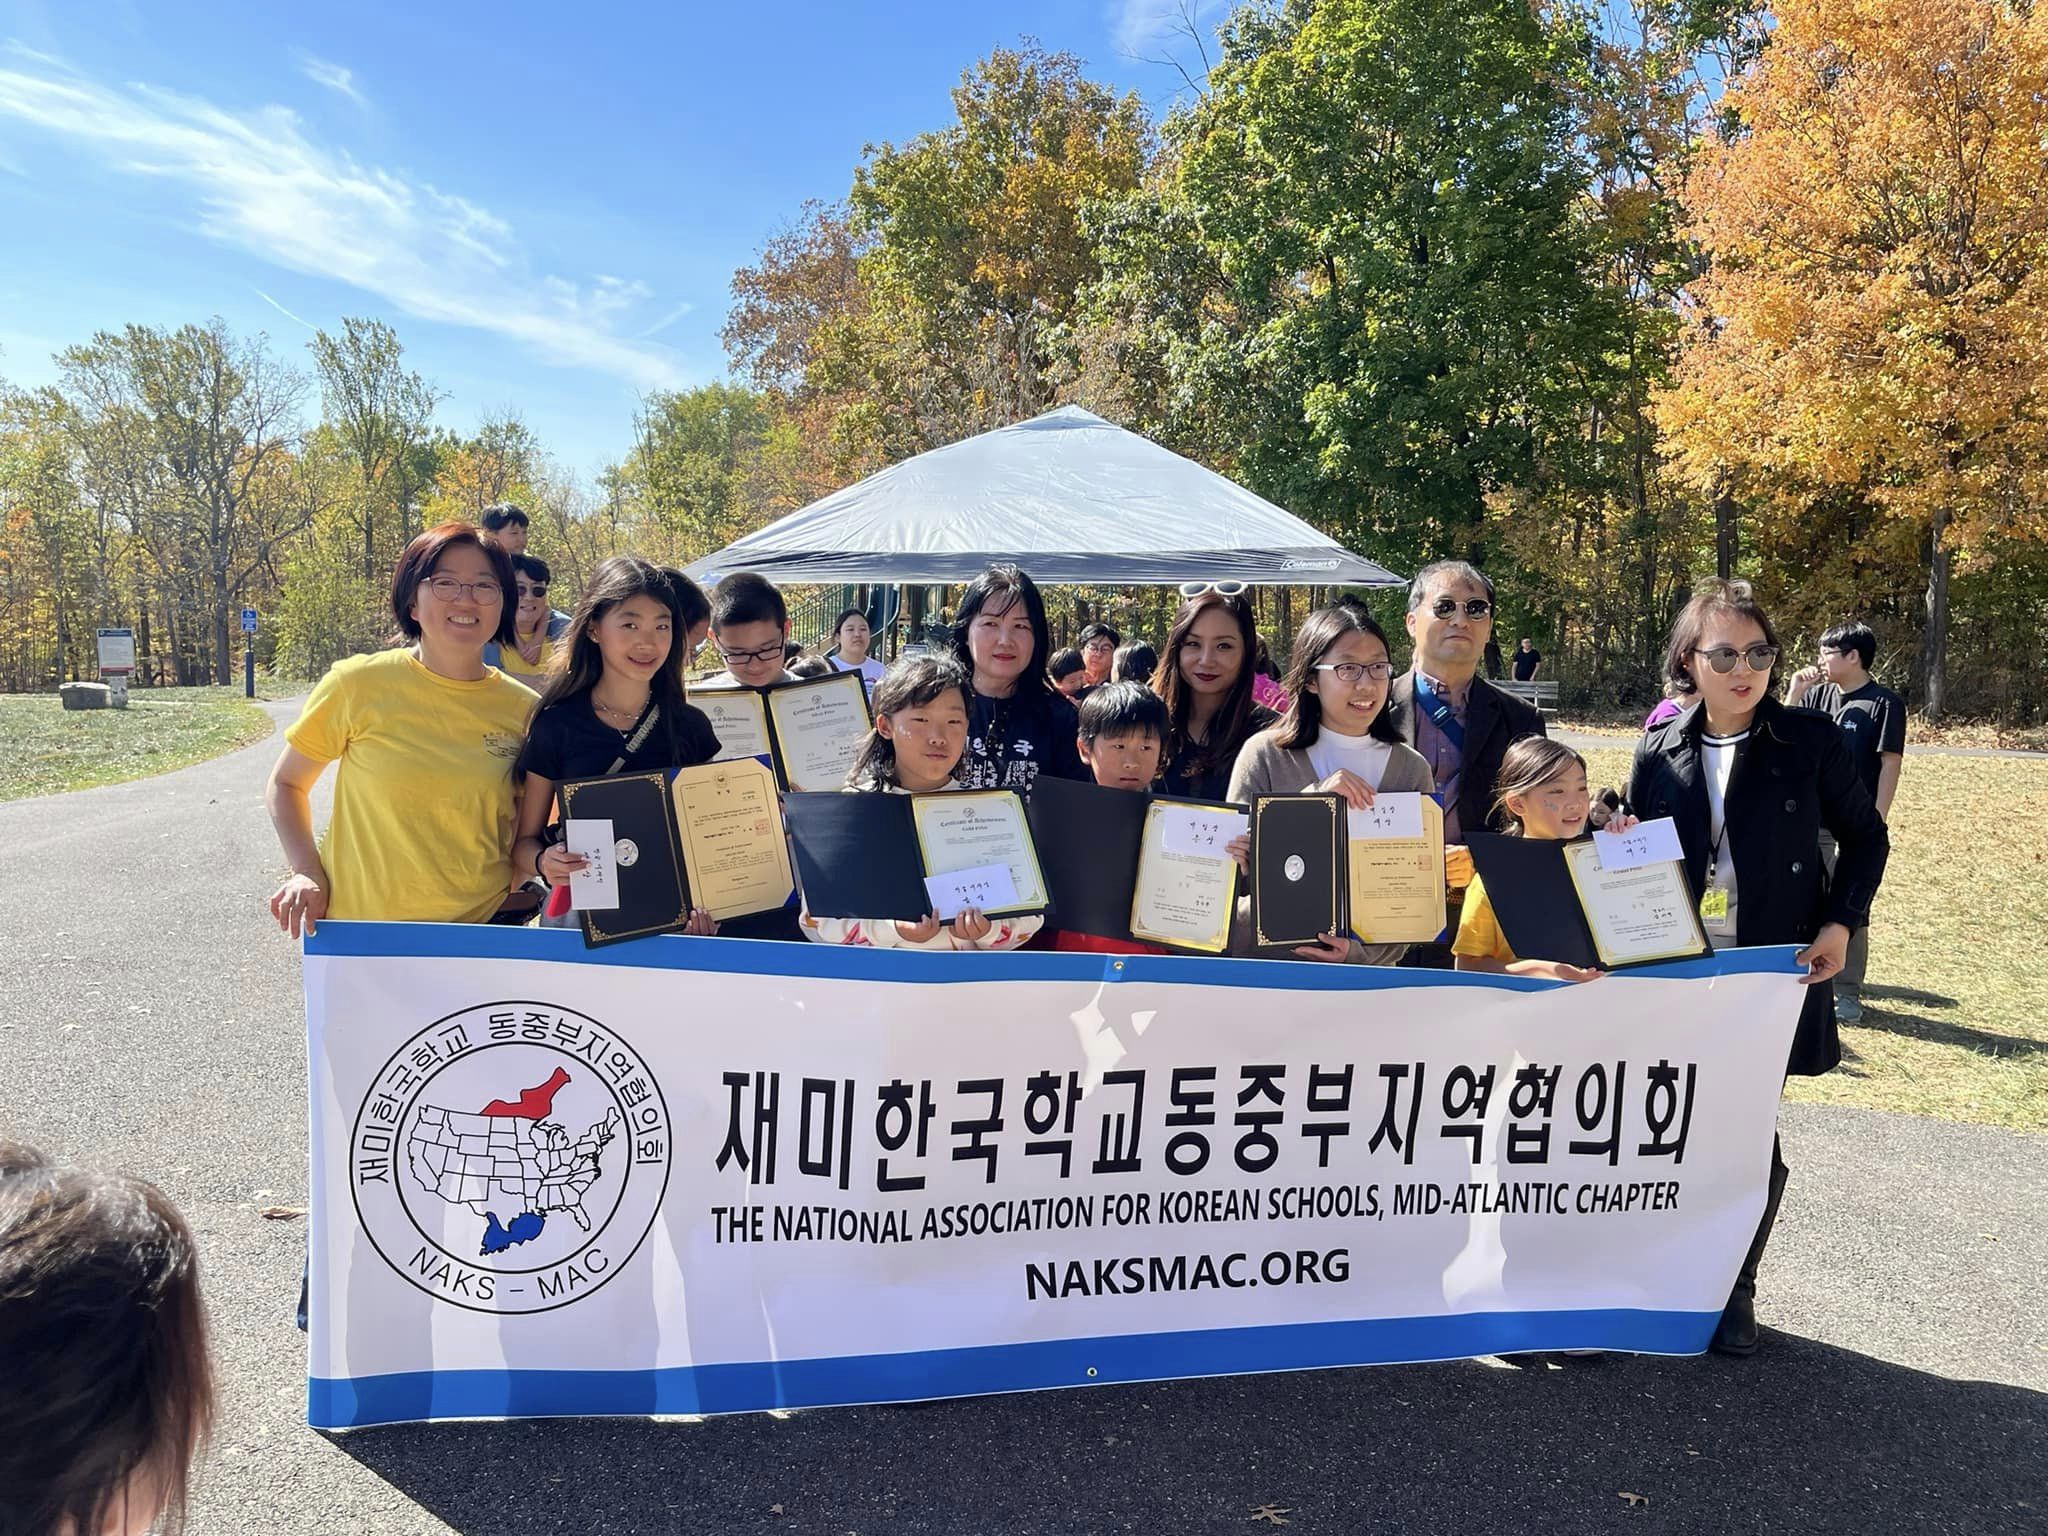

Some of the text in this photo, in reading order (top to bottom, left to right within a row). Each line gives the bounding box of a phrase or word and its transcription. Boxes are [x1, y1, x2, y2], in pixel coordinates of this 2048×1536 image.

[360, 1024, 472, 1184] 재미한국학교
[715, 1059, 1697, 1192] 재미한국학교동중부지역협의회
[711, 1181, 1680, 1243] THE NATIONAL ASSOCIATION FOR KOREAN SCHOOLS, MID-ATLANTIC CHAPTER
[408, 1246, 496, 1300] NAKS
[537, 1248, 609, 1301] MAC
[1025, 1249, 1350, 1301] NAKSMAC.ORG
